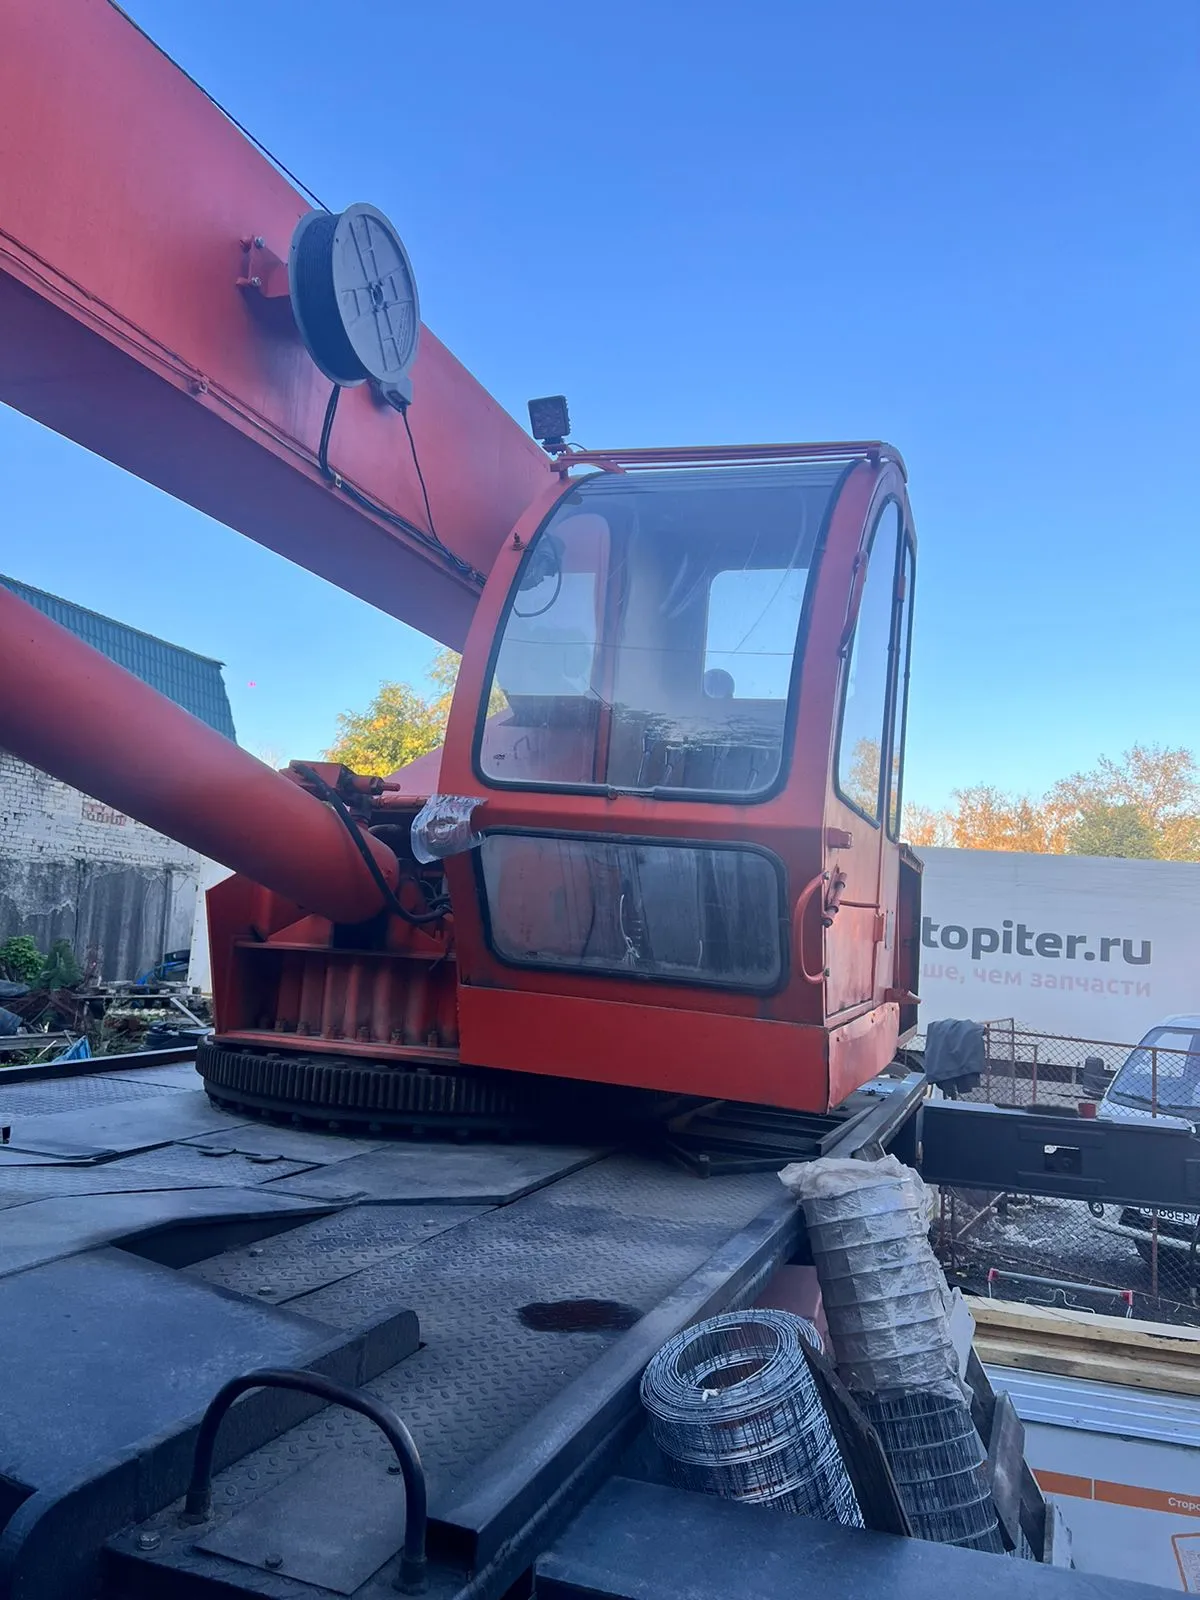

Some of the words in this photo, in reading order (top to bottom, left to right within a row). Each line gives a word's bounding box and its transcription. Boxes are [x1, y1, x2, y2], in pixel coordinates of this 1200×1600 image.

[922, 916, 1152, 965] topiter.ru
[973, 966, 1023, 986] чем
[1030, 971, 1151, 998] запчасти
